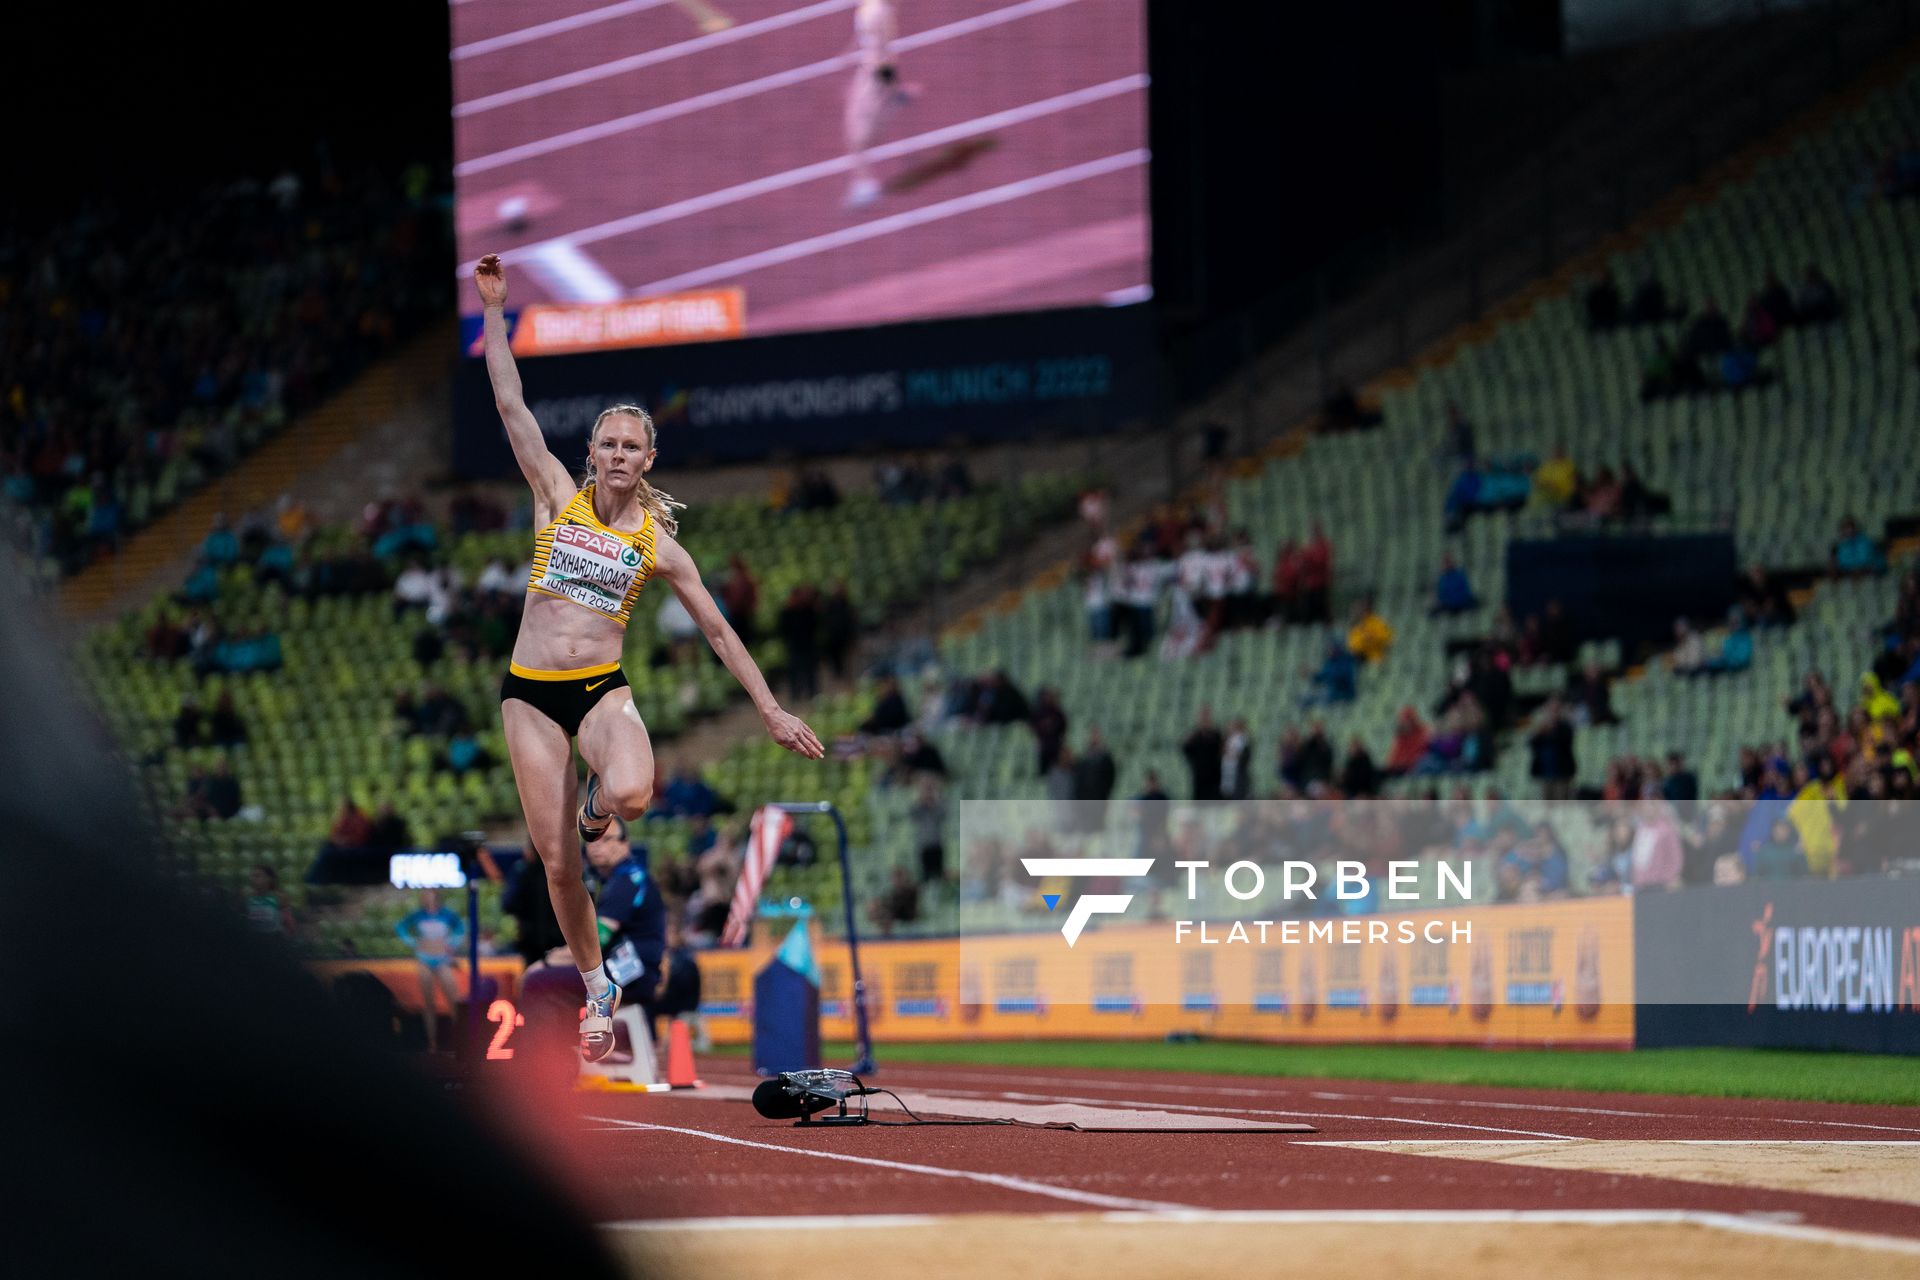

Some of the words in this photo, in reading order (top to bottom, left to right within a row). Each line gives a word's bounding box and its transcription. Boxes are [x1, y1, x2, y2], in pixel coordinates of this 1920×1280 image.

[557, 525, 620, 558] SPAR
[549, 549, 632, 592] ECKHARDT-NOACK
[588, 594, 616, 613] 2022
[1775, 926, 1893, 1014] EUROPEAN
